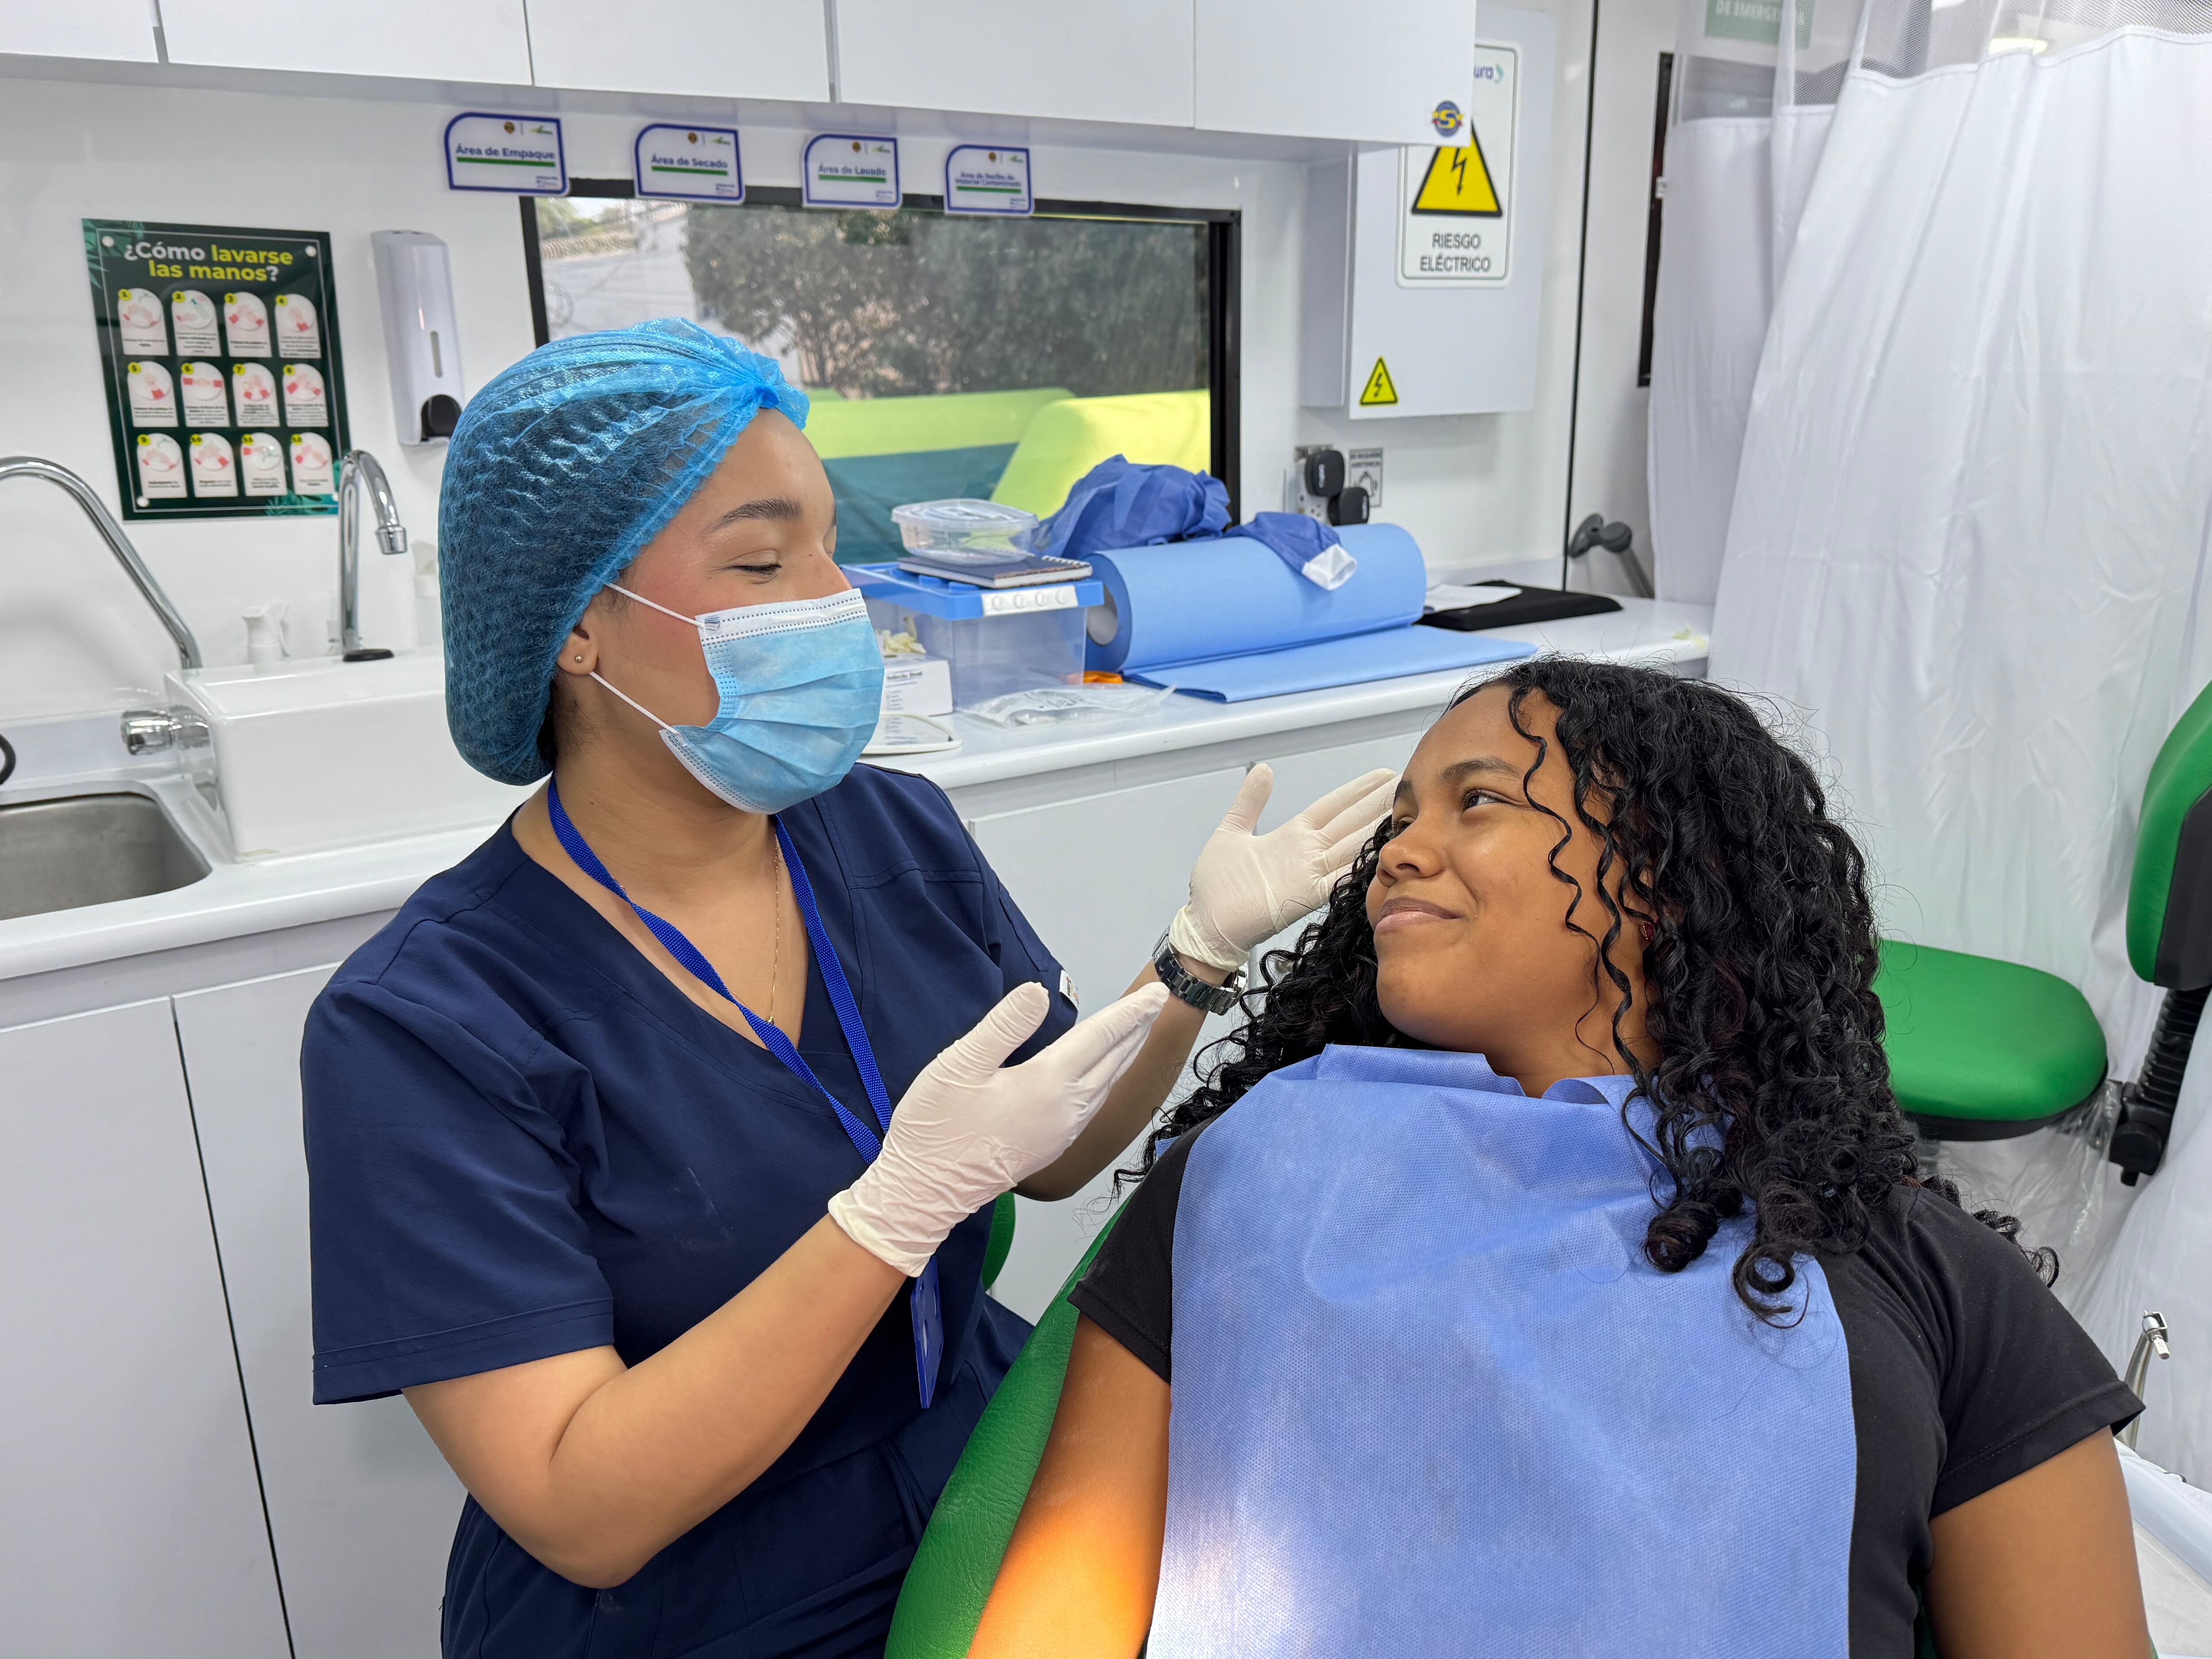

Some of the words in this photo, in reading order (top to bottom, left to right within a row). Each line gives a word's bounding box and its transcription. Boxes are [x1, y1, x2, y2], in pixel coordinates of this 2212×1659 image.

[456, 142, 482, 155] Área
[485, 146, 499, 156] de
[502, 147, 555, 161] Empaque
[651, 153, 675, 165] Área
[676, 157, 690, 165] de
[692, 158, 728, 168] Secado
[818, 162, 840, 174] Área
[842, 165, 853, 173] de
[854, 166, 887, 176] Lavado
[1432, 233, 1482, 249] RIESGO
[123, 241, 206, 261] ¿Cómo
[211, 244, 293, 265] lavarse
[1419, 251, 1492, 272] ELÉCTRICO
[148, 259, 183, 278] las
[188, 265, 279, 282] manos?
